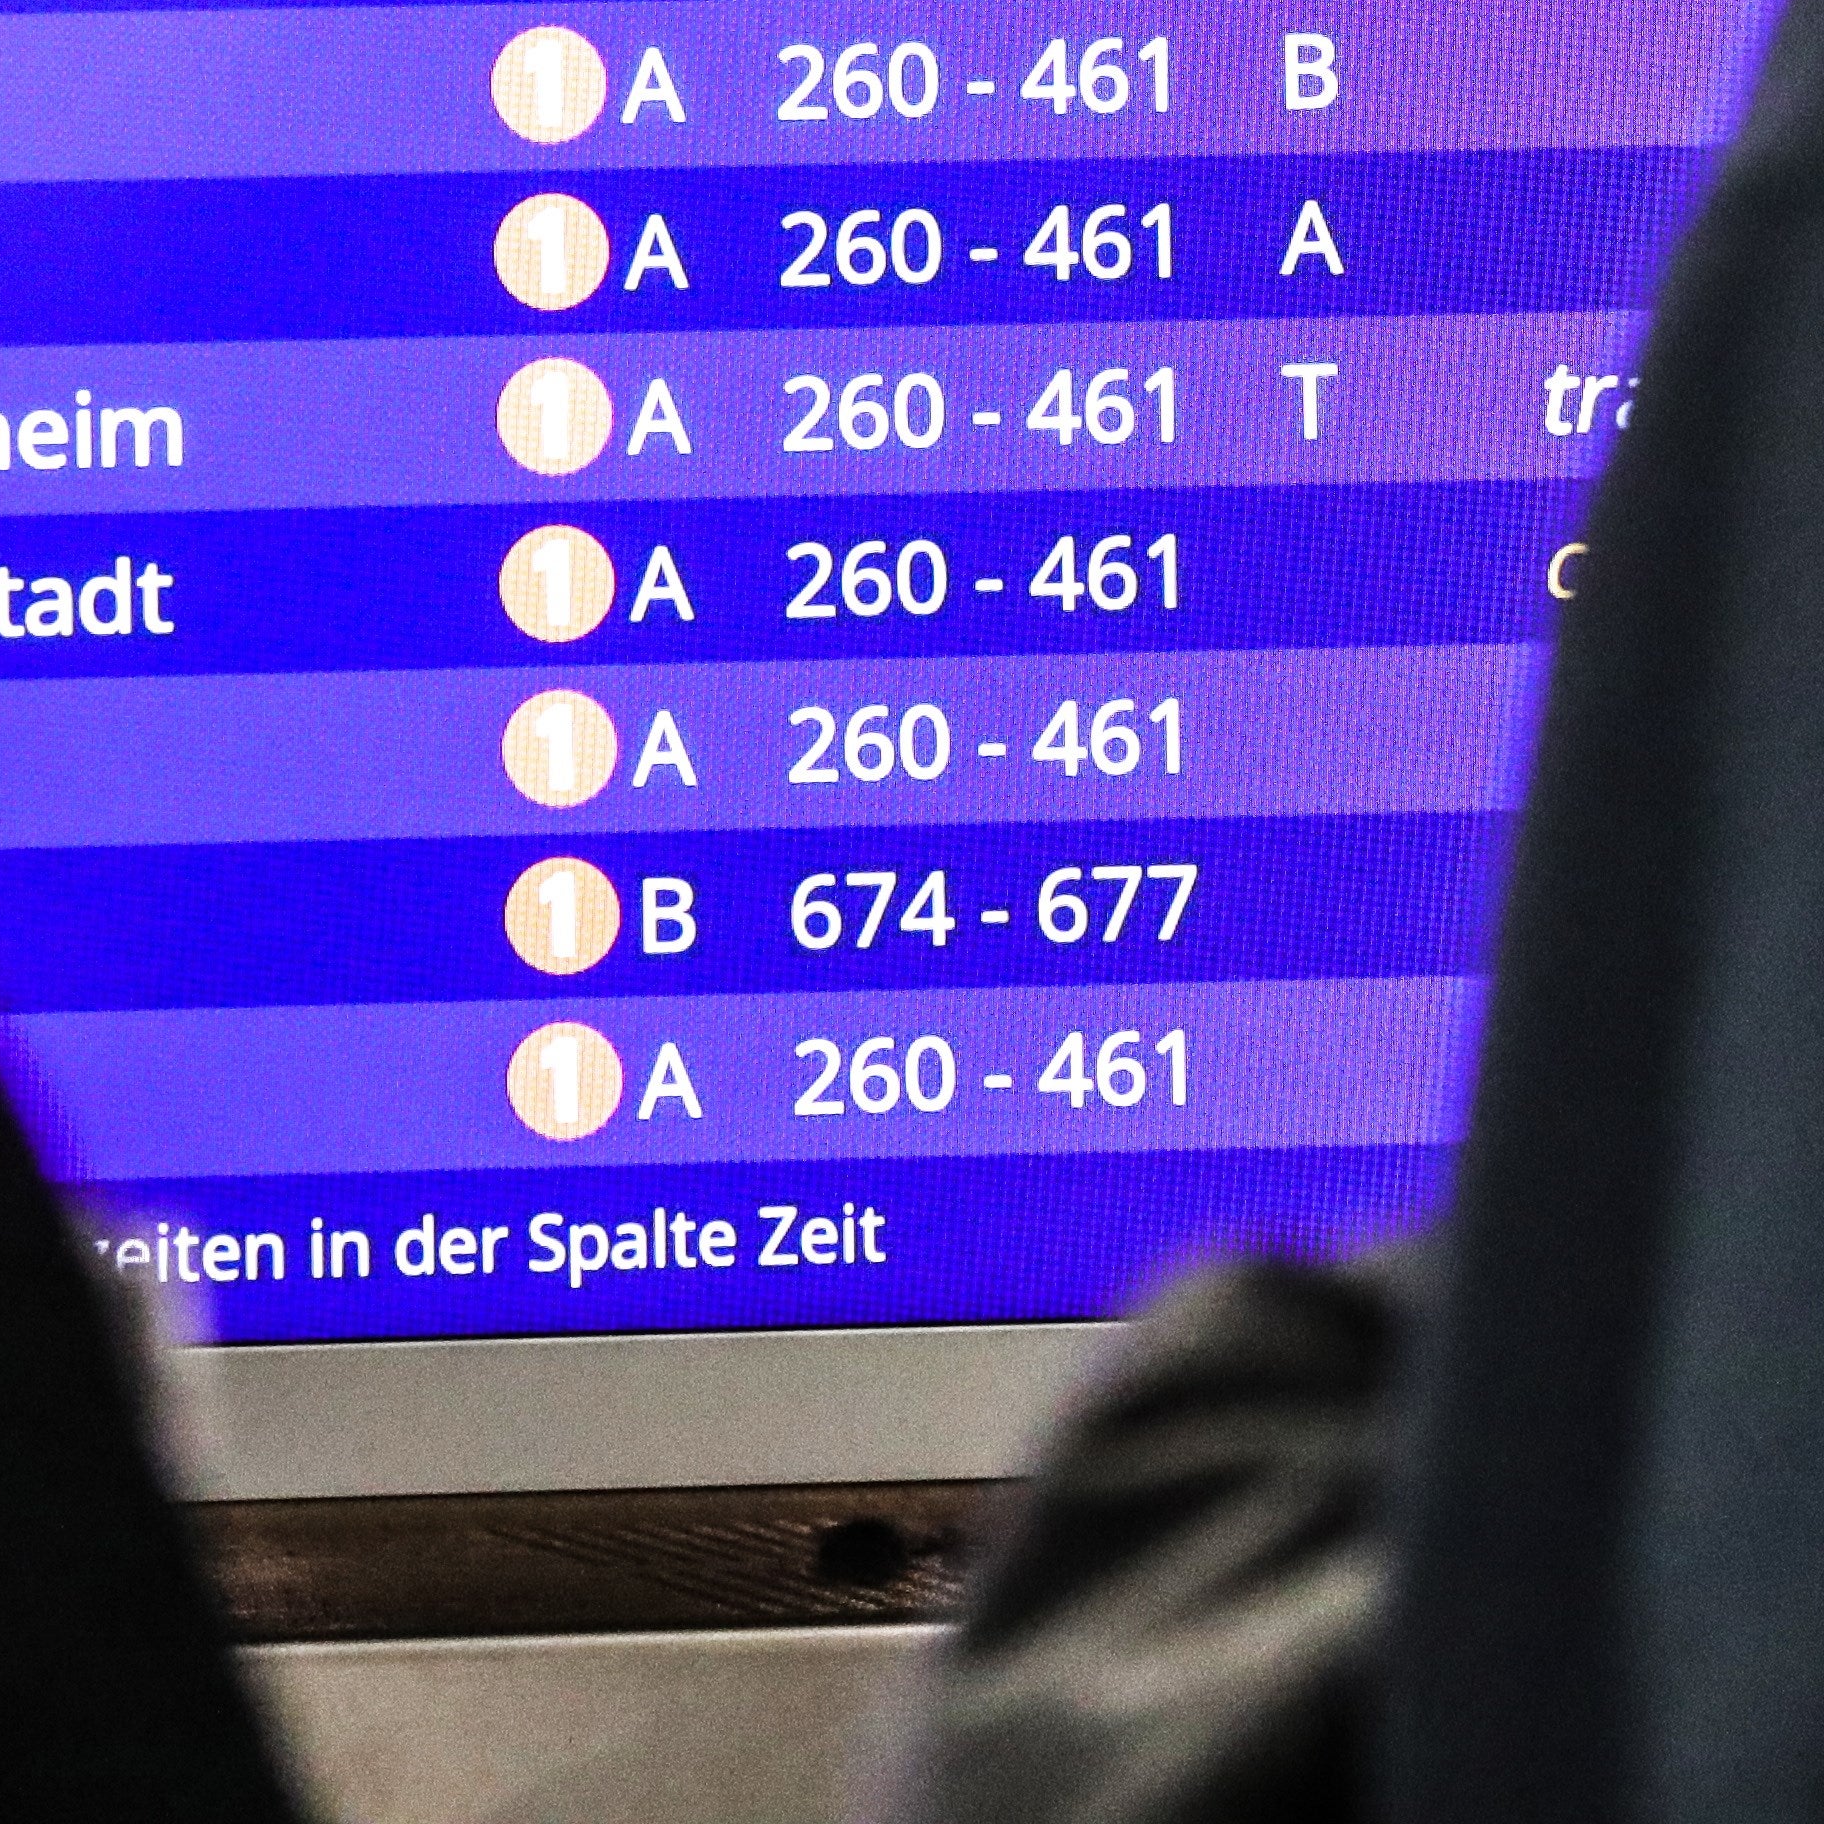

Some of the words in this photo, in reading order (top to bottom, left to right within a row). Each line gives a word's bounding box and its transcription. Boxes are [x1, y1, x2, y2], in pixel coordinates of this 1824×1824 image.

[521, 35, 565, 130] 1
[619, 45, 687, 125] A
[776, 39, 940, 124] 260
[1018, 34, 1170, 116] 461
[1283, 31, 1342, 113] B
[525, 203, 569, 296] 1
[623, 213, 690, 291] A
[779, 207, 943, 288] 260
[1023, 202, 1172, 281] 461
[1278, 199, 1345, 277] A
[528, 366, 572, 462] 1
[626, 376, 693, 457] A
[781, 370, 946, 453] 260
[1024, 364, 1176, 447] 461
[1277, 361, 1340, 442] T
[531, 534, 575, 628] 1
[629, 544, 696, 623] A
[785, 538, 948, 620] 260
[1028, 532, 1178, 612] 461
[533, 699, 577, 794] 1
[631, 709, 698, 789] A
[787, 703, 952, 785] 260
[1030, 695, 1182, 778] 461
[536, 866, 580, 960] 1
[641, 876, 697, 955] B
[790, 869, 956, 950] 674
[1037, 863, 1198, 944] 677
[539, 1030, 583, 1126] 1
[637, 1040, 703, 1121] A
[793, 1033, 957, 1117] 260
[1035, 1028, 1188, 1109] 461
[93, 1220, 286, 1285] eiten
[309, 1216, 372, 1281] in
[394, 1212, 510, 1277] der
[527, 1206, 737, 1290] Spalte
[757, 1200, 887, 1267] Zeit
